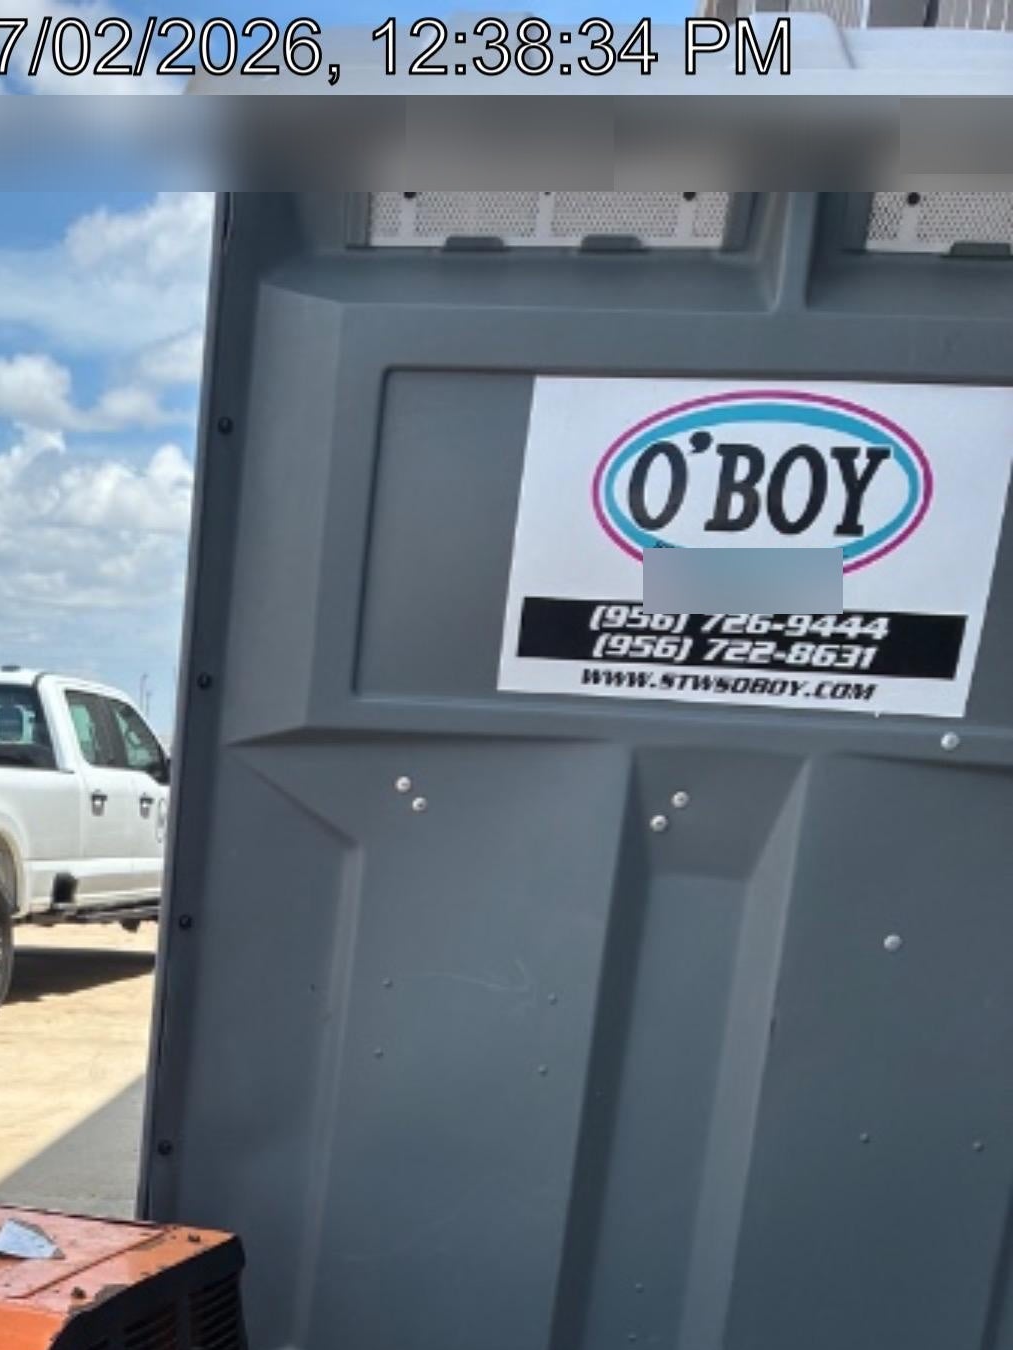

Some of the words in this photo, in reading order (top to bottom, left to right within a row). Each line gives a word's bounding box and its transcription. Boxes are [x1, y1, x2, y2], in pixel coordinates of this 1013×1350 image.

[627, 431, 891, 536] O'BOY
[590, 605, 689, 633] (956)
[701, 613, 890, 640] 726-9444
[592, 633, 693, 664] (956)
[703, 638, 879, 669] 722-8631
[581, 668, 878, 701] WWW.STWSOBOY.COM
